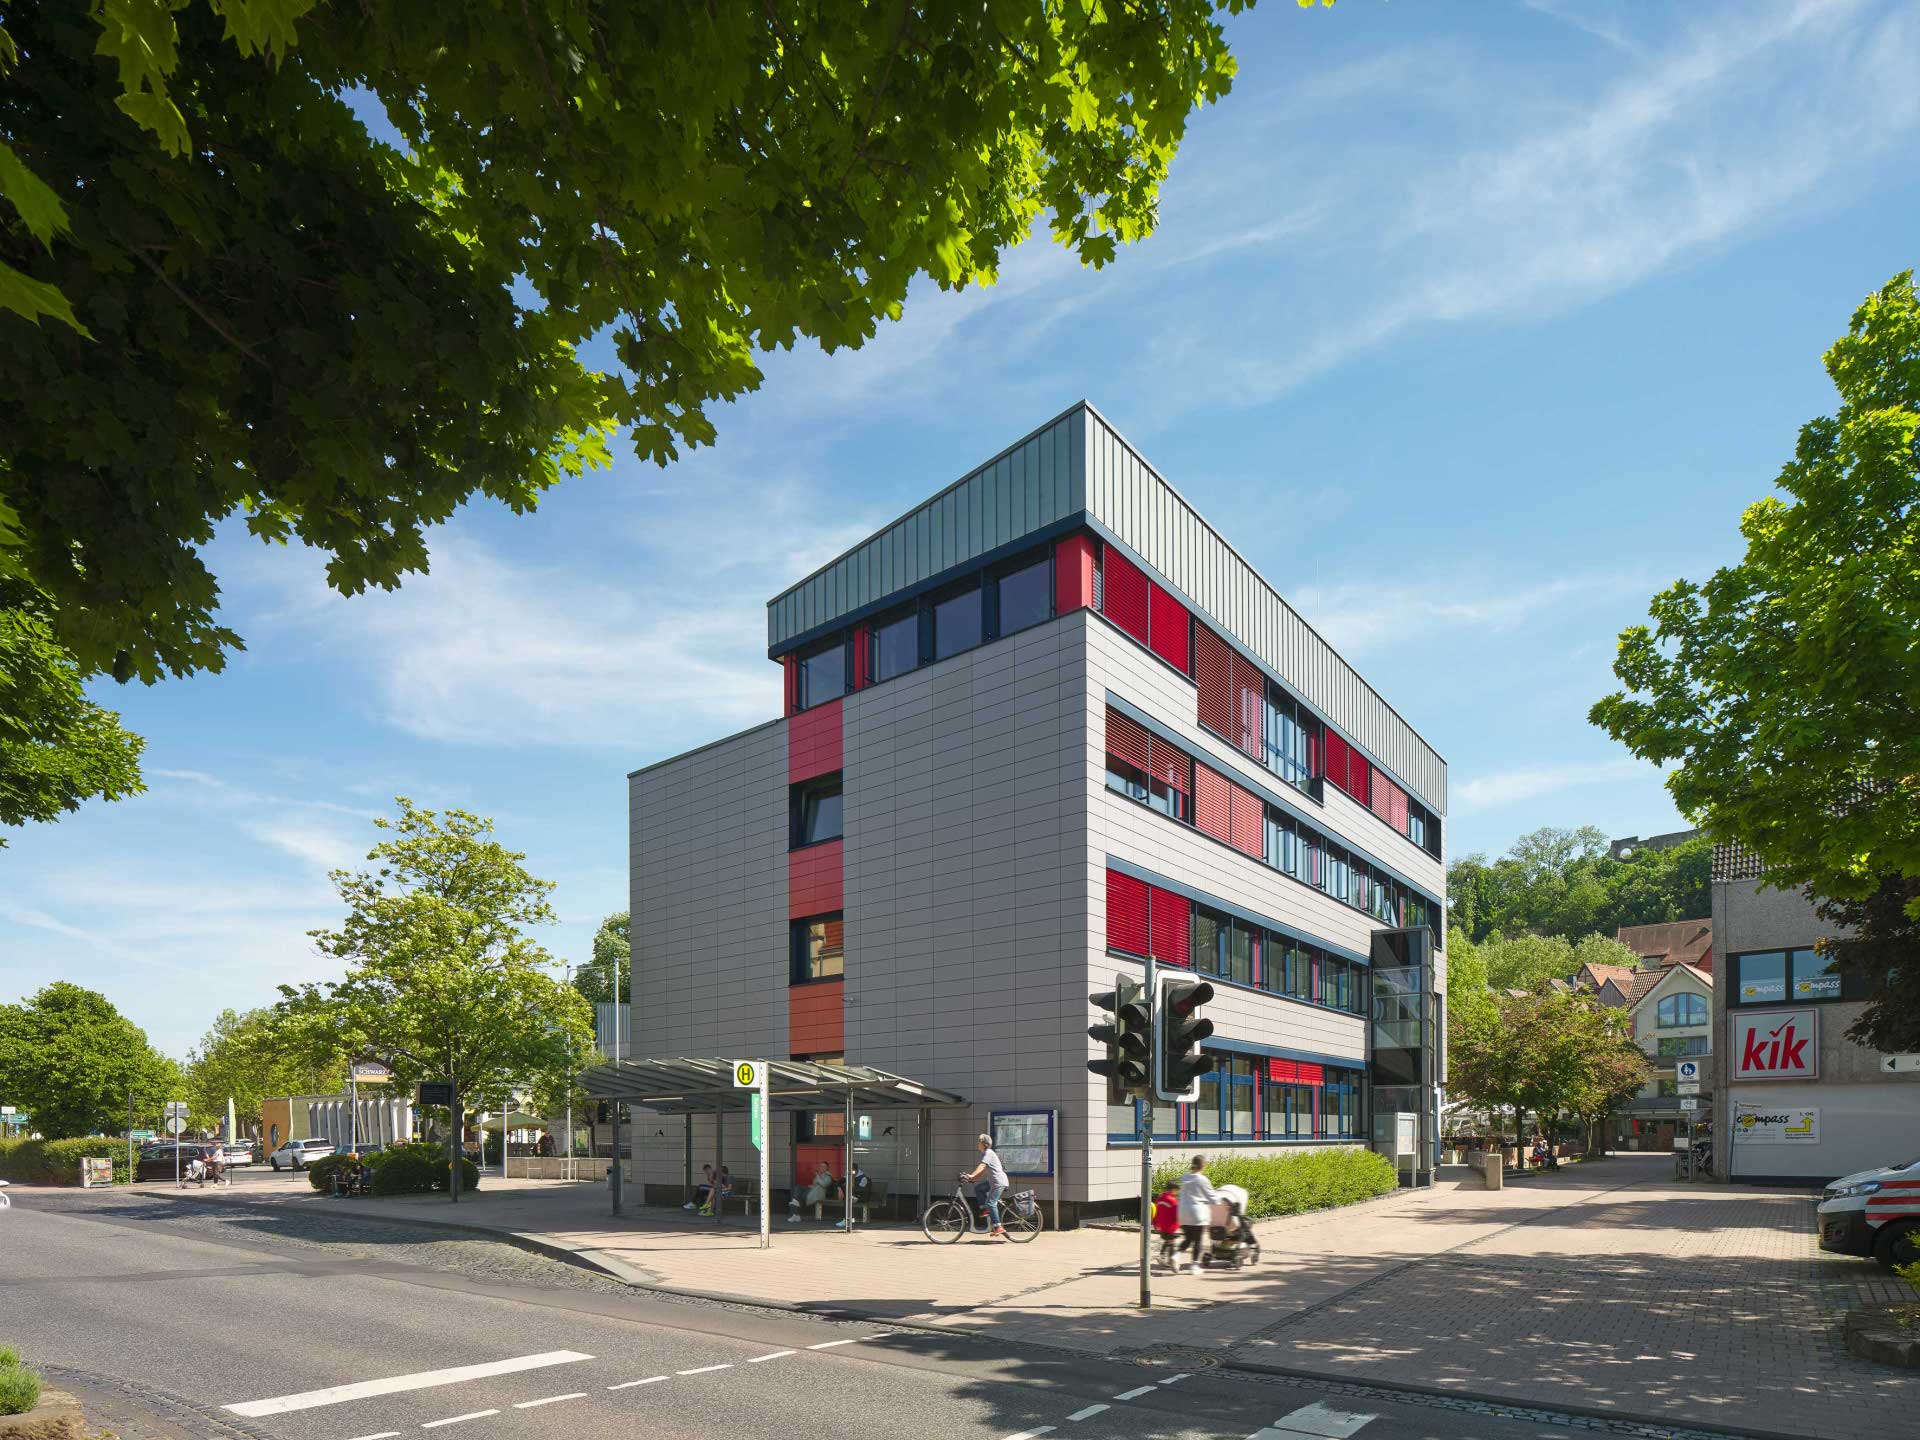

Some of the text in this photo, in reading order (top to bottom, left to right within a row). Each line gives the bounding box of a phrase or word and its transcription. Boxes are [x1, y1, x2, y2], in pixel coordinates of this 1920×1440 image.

[1794, 981, 1841, 993] compass
[1741, 1018, 1809, 1071] kik
[741, 1067, 751, 1081] H
[1736, 1115, 1790, 1128] compass
